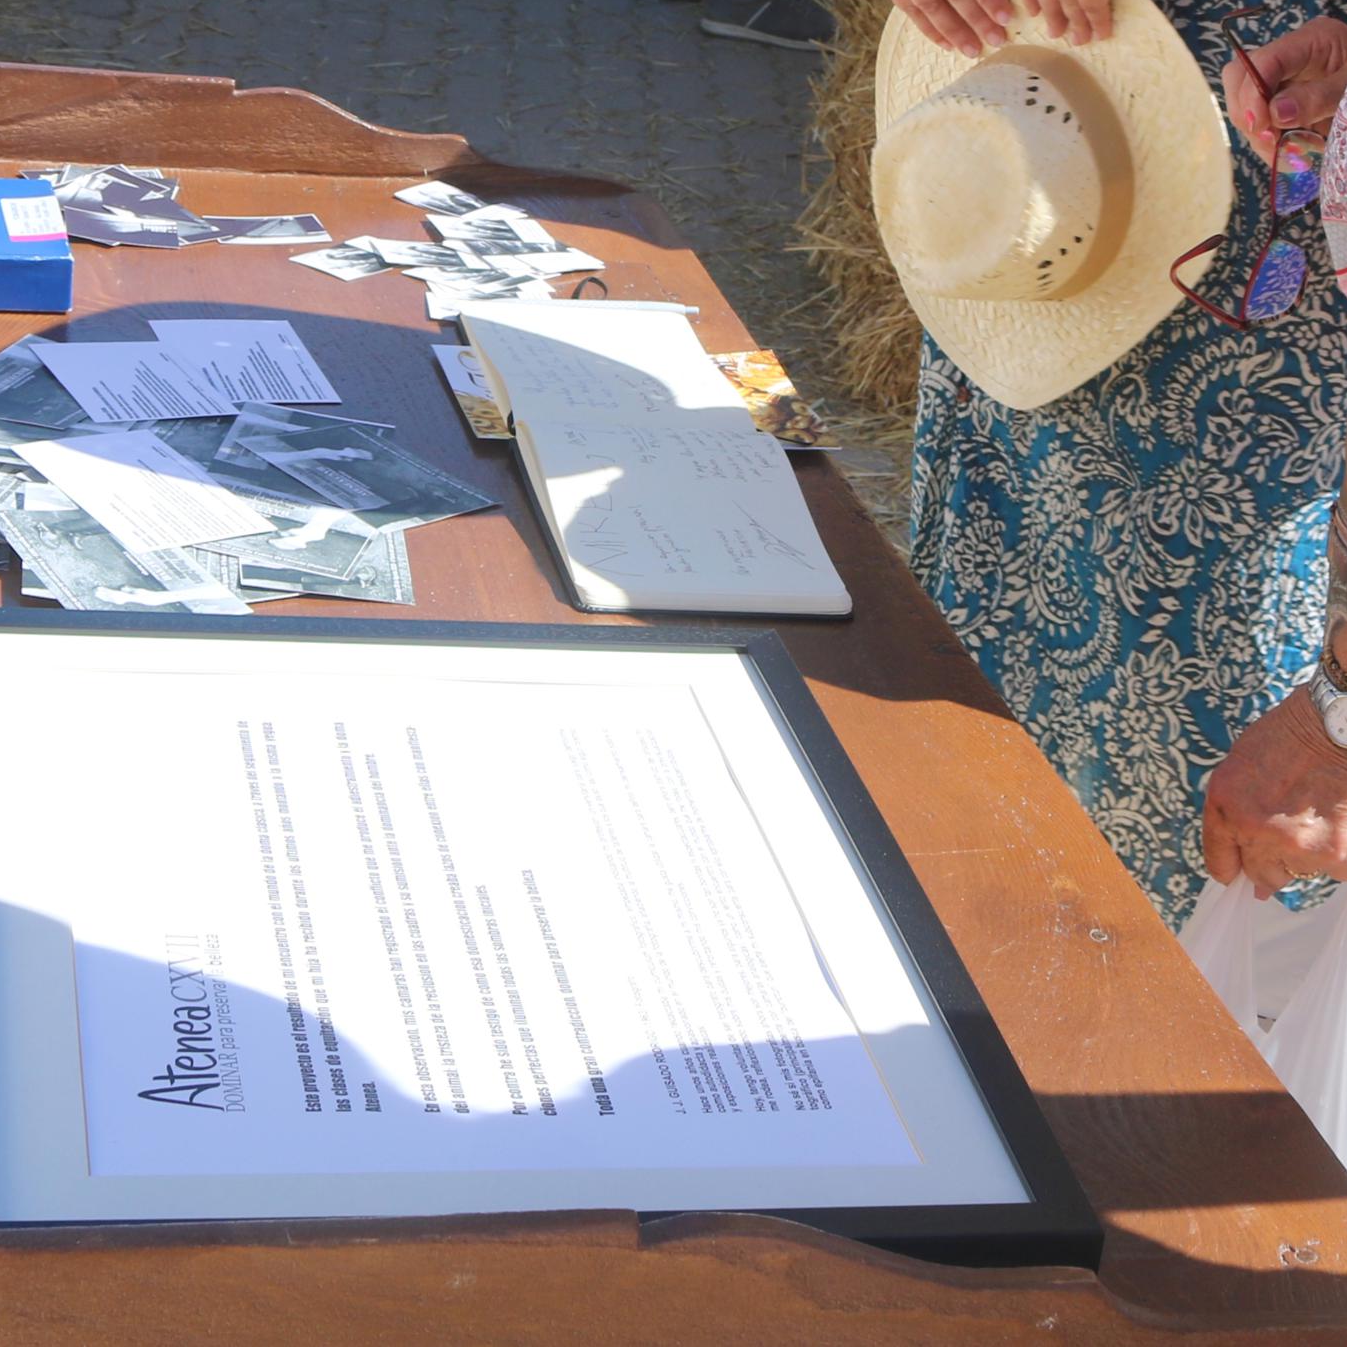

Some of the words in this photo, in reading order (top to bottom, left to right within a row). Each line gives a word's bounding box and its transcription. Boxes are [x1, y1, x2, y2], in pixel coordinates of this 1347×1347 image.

[212, 978, 236, 1024] preservar
[285, 992, 305, 1031] resultado
[506, 989, 527, 1025] iluminan
[401, 1010, 416, 1025] mis
[484, 1008, 503, 1037] testigo
[223, 1026, 240, 1049] para
[316, 1006, 339, 1052] equitación
[517, 1027, 534, 1042] que
[433, 1025, 453, 1056] tristeza
[493, 1039, 510, 1056] sido
[728, 1043, 749, 1073] voluntad
[798, 1048, 810, 1058] en
[296, 1054, 319, 1092] proyecto
[523, 1044, 547, 1084] perfectas
[582, 1055, 603, 1075] gran
[683, 1056, 697, 1073] años
[694, 1051, 718, 1091] autodidacta
[780, 1067, 793, 1081] mis
[225, 1052, 246, 1112] DOMINAR
[329, 1067, 348, 1096] clases
[502, 1071, 523, 1099] contra
[589, 1076, 607, 1093] una
[657, 1064, 680, 1098] GUISADO
[691, 1075, 705, 1093] unos
[711, 1060, 737, 1106] exposiciones
[743, 1073, 759, 1095] tengo
[758, 1076, 774, 1099] rodea,
[787, 1081, 797, 1089] si
[304, 1093, 322, 1112] Este
[361, 1082, 382, 1112] Atenea.
[419, 1083, 437, 1101] esta
[536, 1087, 558, 1116] ciones
[789, 1090, 801, 1098] sé
[816, 1088, 833, 1109] como
[334, 1098, 352, 1112] las
[452, 1100, 470, 1114] del
[511, 1101, 529, 1116] Por
[595, 1094, 615, 1115] Toda
[698, 1095, 713, 1113] Hace
[711, 1093, 727, 1113] como
[754, 1097, 766, 1112] Hoy,
[767, 1099, 779, 1111] me
[794, 1100, 805, 1110] No
